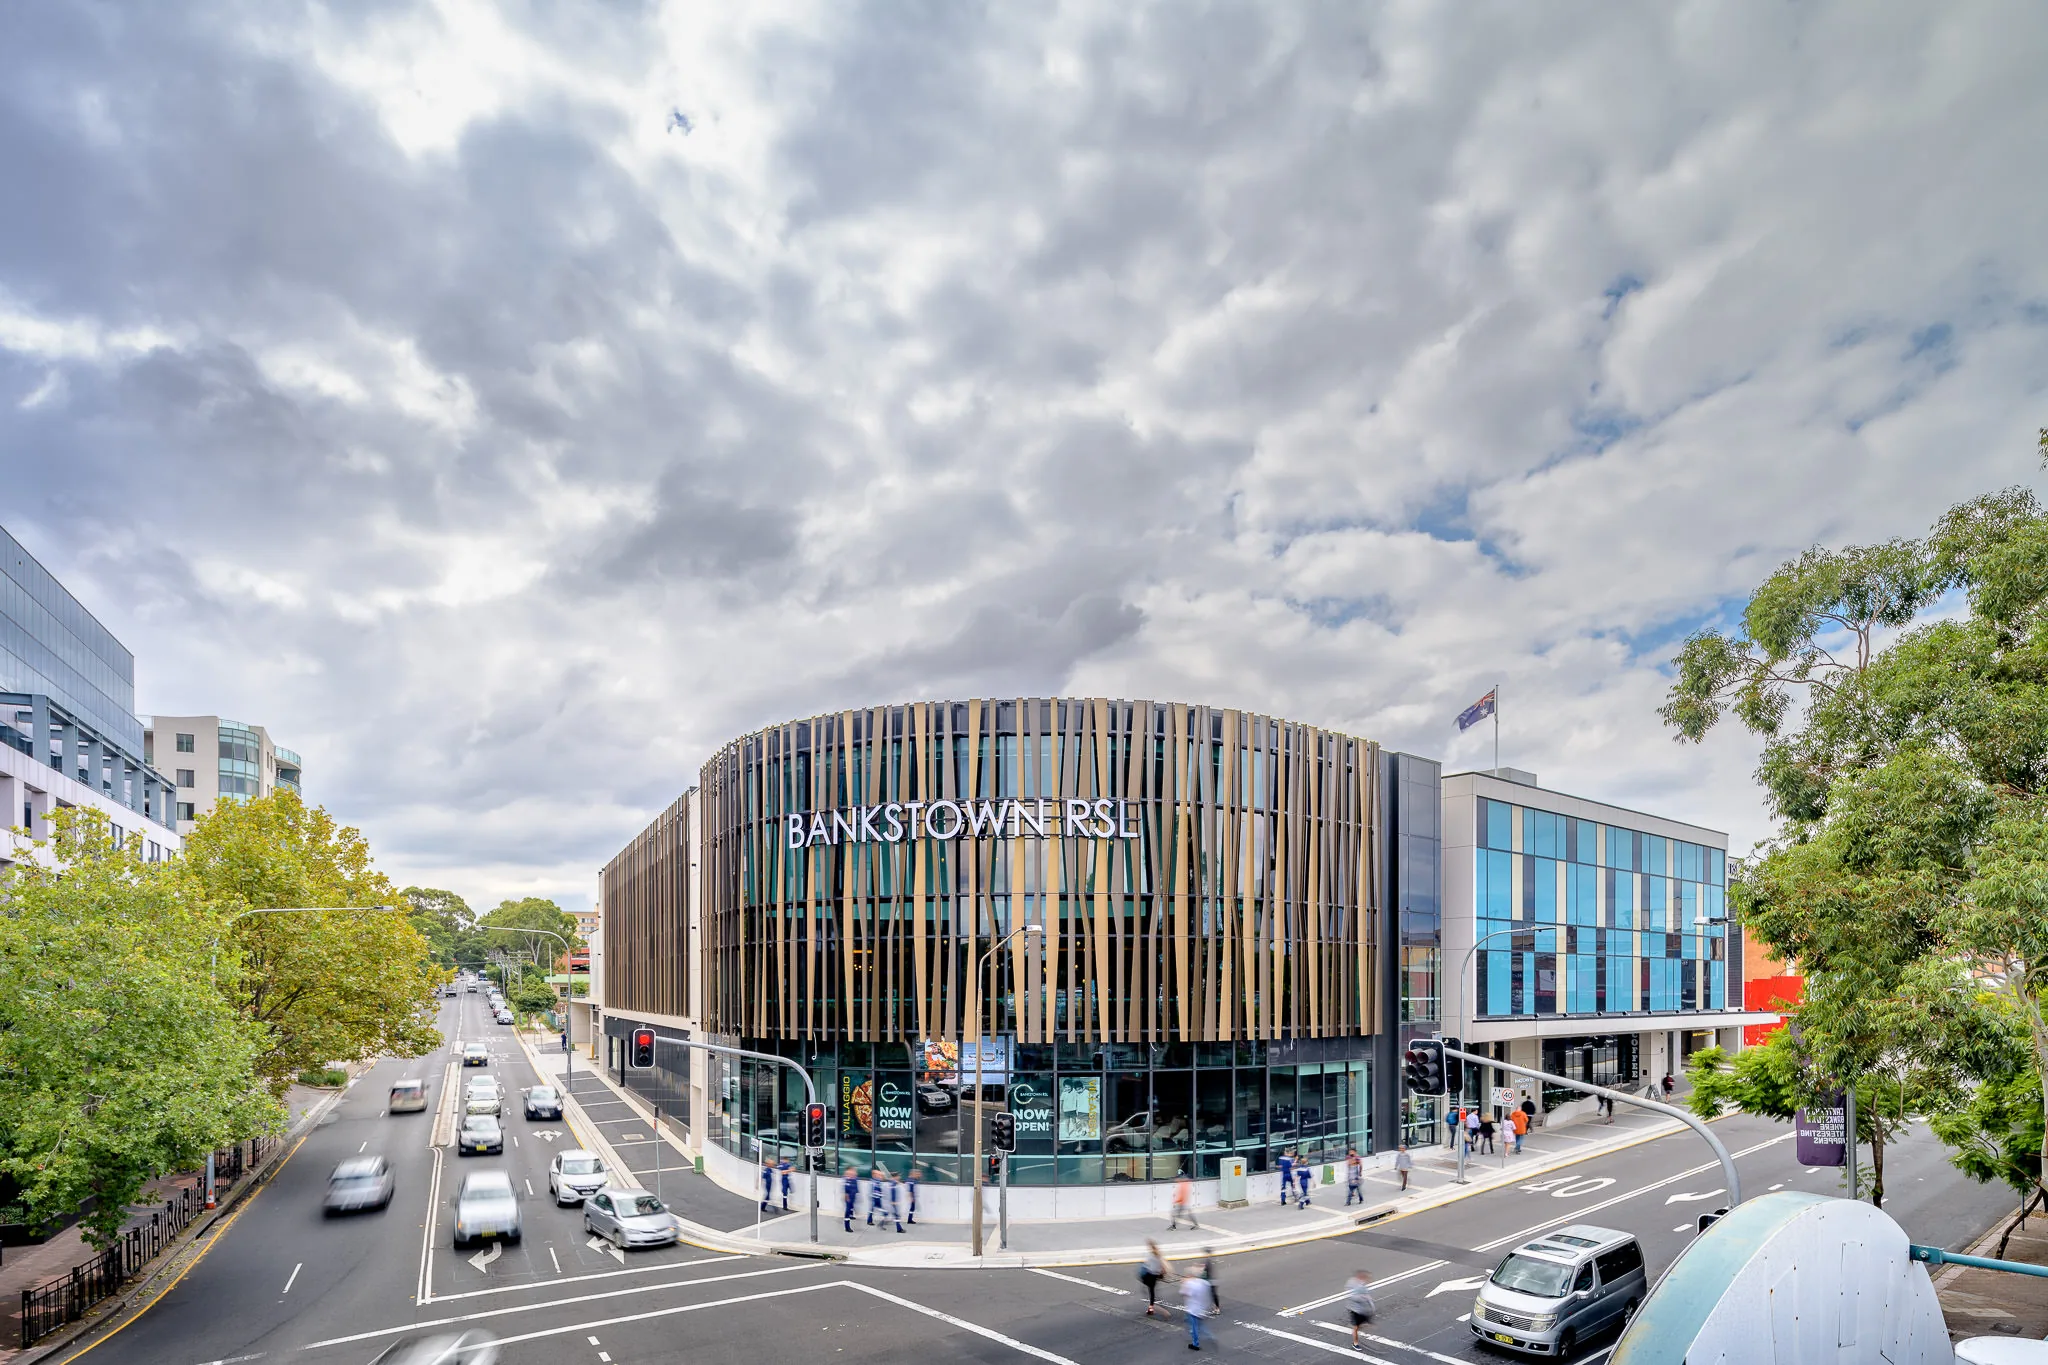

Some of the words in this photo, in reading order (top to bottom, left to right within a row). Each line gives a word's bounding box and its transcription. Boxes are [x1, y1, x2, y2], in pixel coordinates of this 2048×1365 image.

[788, 799, 1045, 849] BANKSTOWN
[1066, 799, 1139, 838] RSL
[1631, 1033, 1639, 1078] COFFEE
[843, 1076, 851, 1132] VILLAGGIO
[880, 1107, 912, 1118] NOW
[1013, 1108, 1049, 1120] NOW
[1088, 1079, 1097, 1138] VILLAGGIO
[880, 1119, 912, 1129] OPEN!
[1015, 1122, 1049, 1132] OPEN!
[1518, 1175, 1617, 1198] 40
